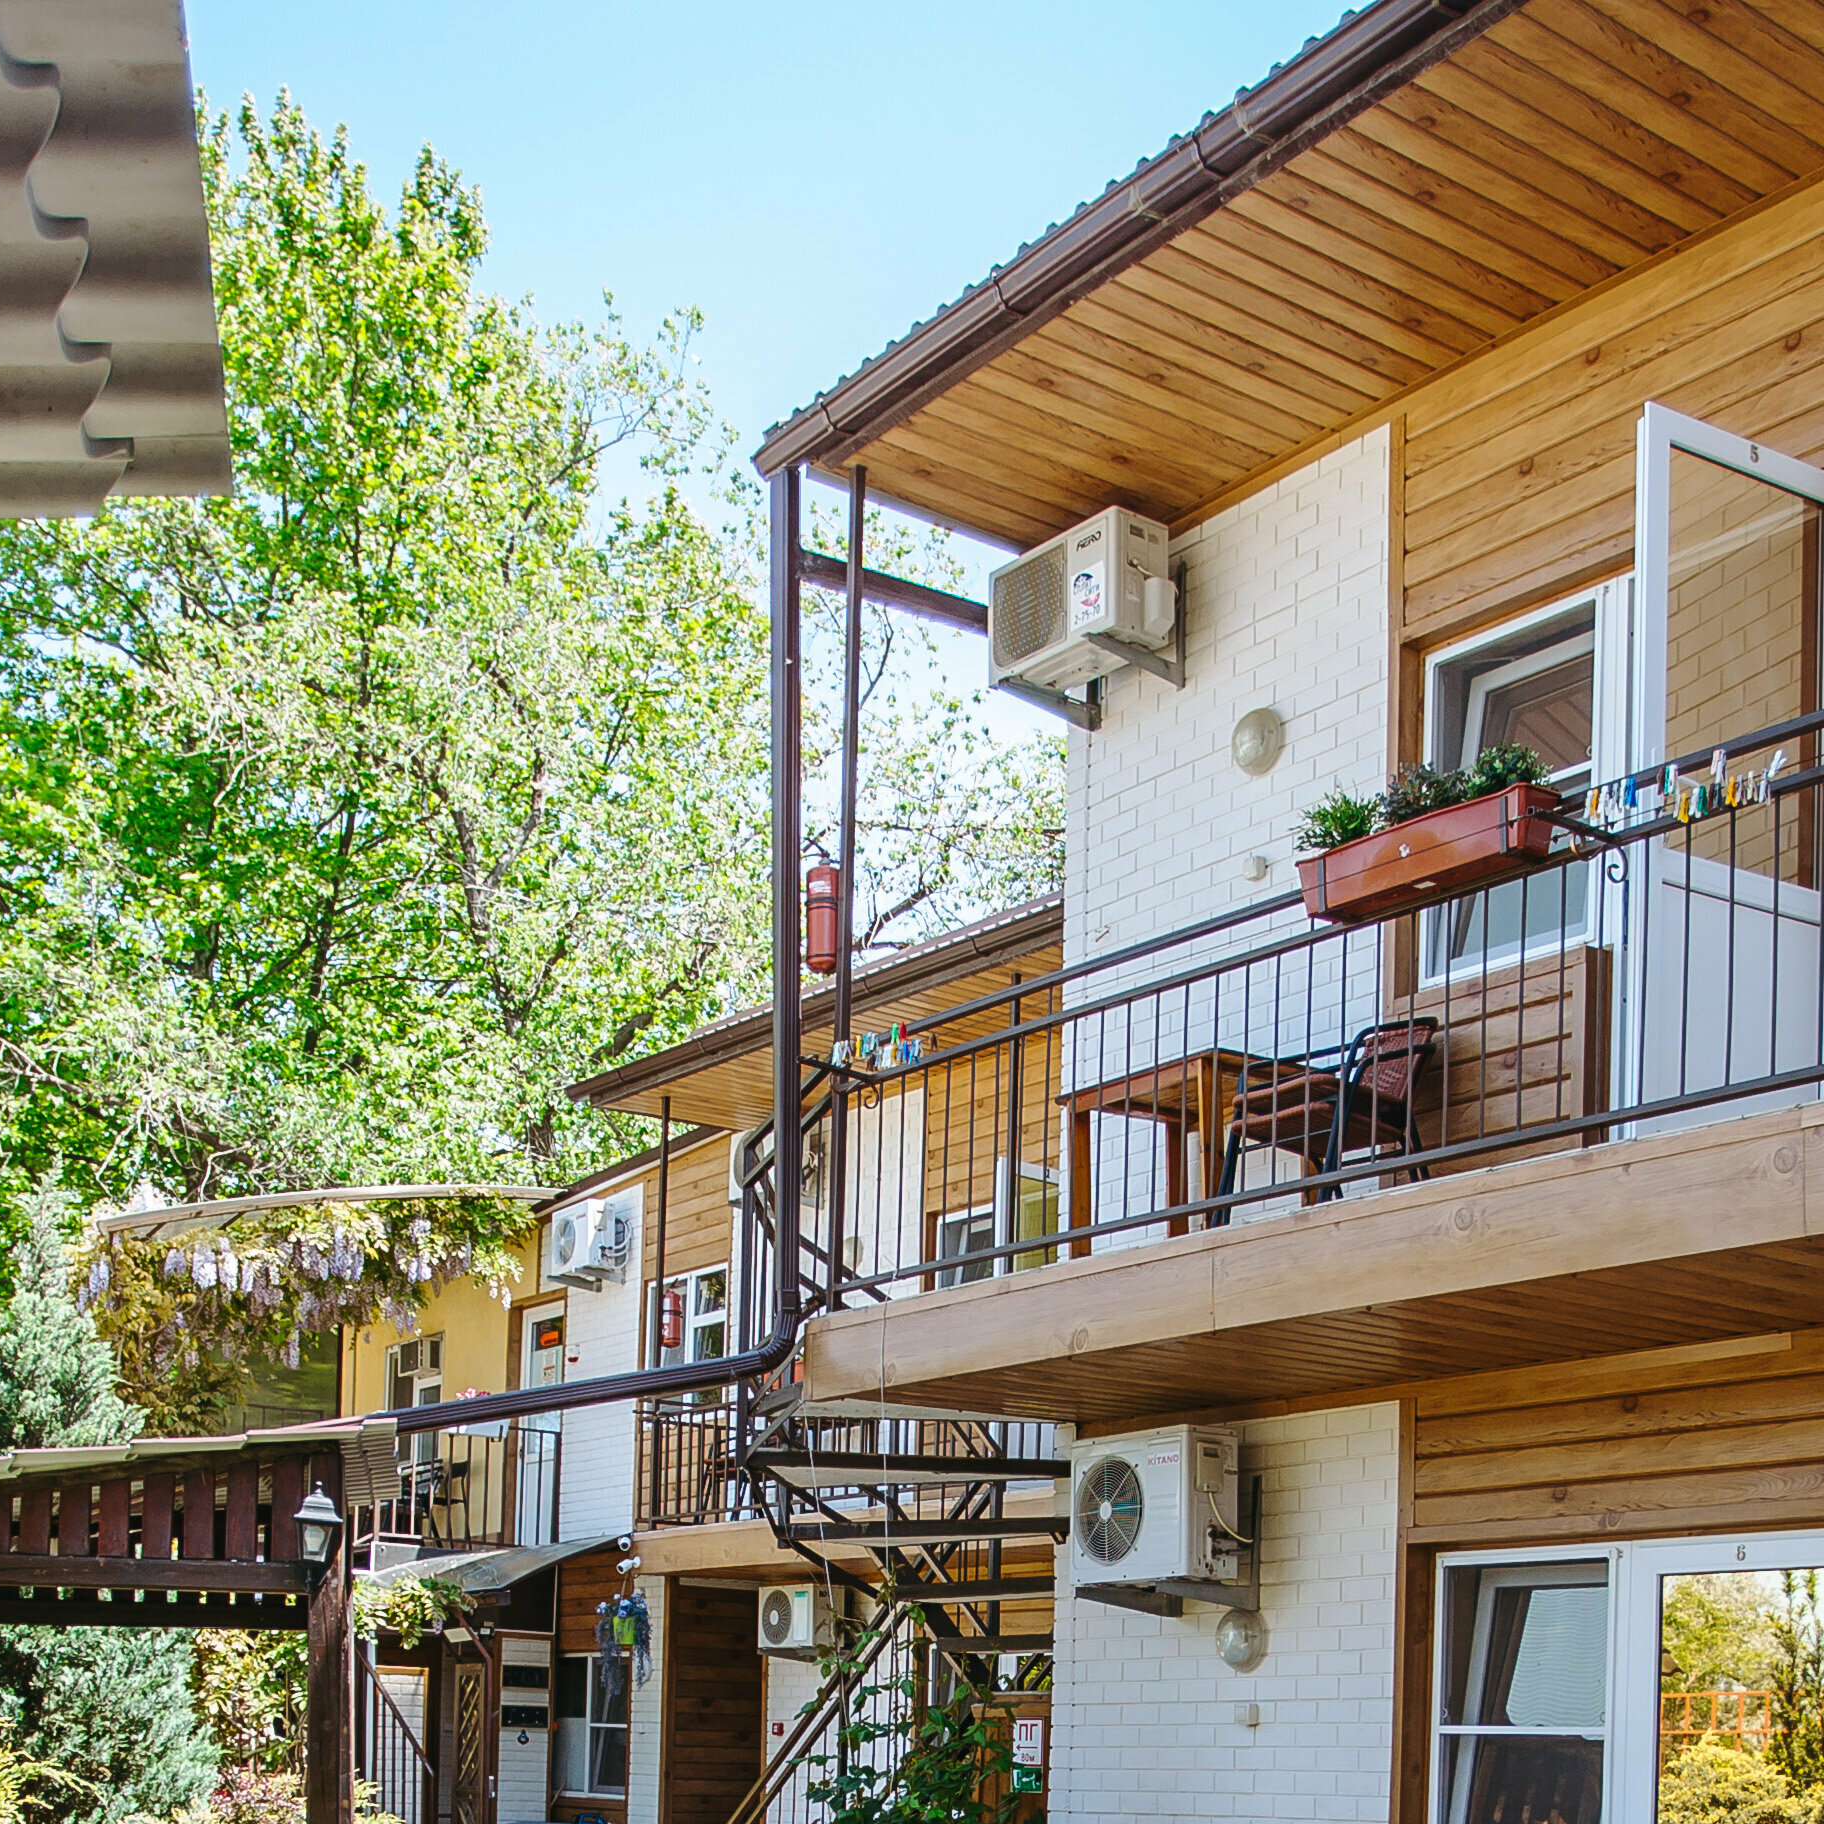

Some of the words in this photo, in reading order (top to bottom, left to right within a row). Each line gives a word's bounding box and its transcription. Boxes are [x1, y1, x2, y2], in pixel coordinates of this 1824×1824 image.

[1750, 444, 1759, 463] 5
[1737, 1544, 1746, 1561] 6
[1019, 1723, 1038, 1741] ПГ
